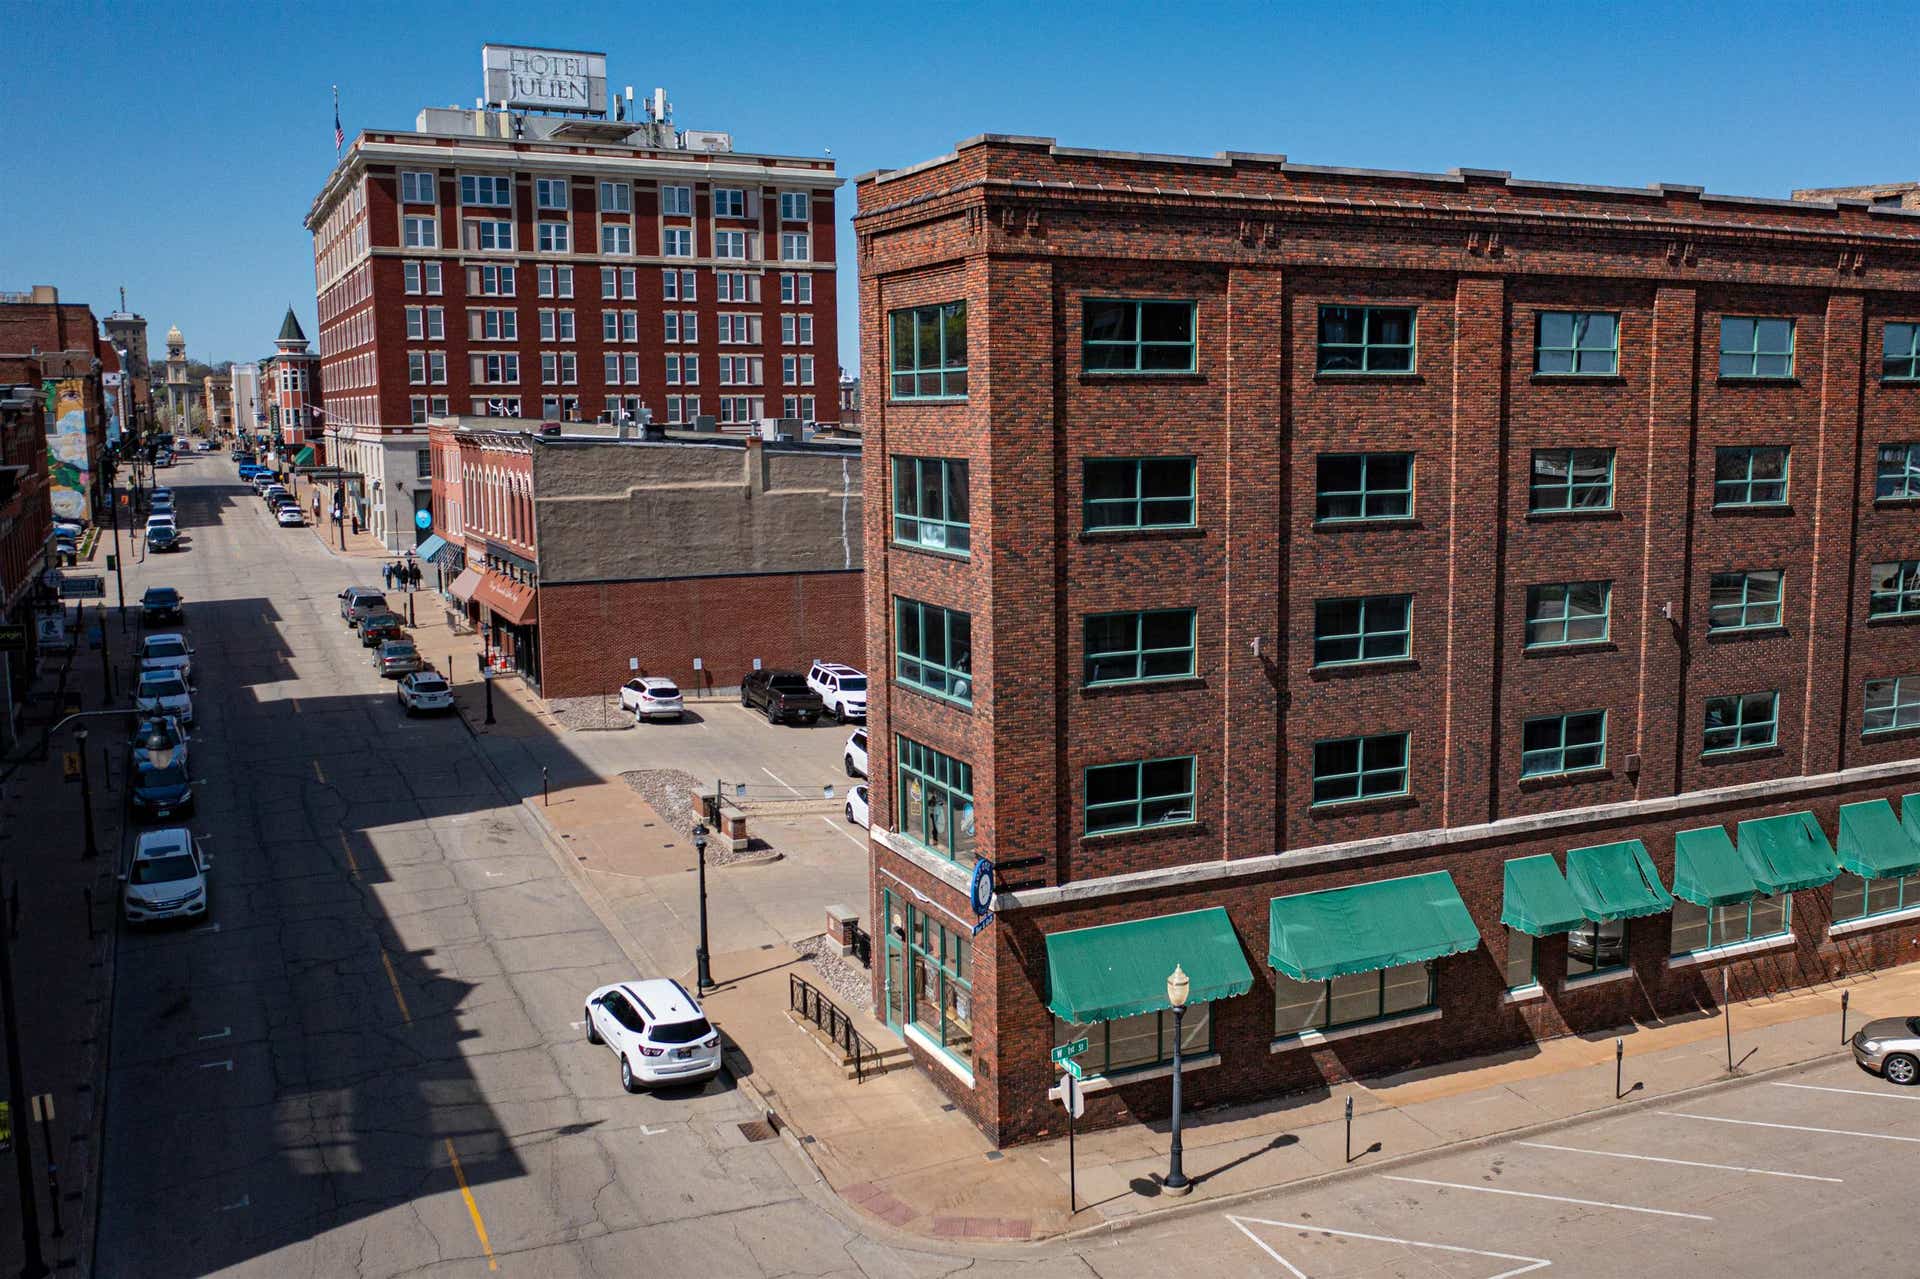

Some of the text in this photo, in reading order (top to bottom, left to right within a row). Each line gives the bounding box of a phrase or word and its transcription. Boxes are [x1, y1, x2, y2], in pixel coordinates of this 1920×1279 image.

[510, 52, 587, 77] HOTEL
[510, 73, 586, 100] JULIEN
[1056, 1049, 1063, 1059] W
[1078, 1043, 1084, 1052] St
